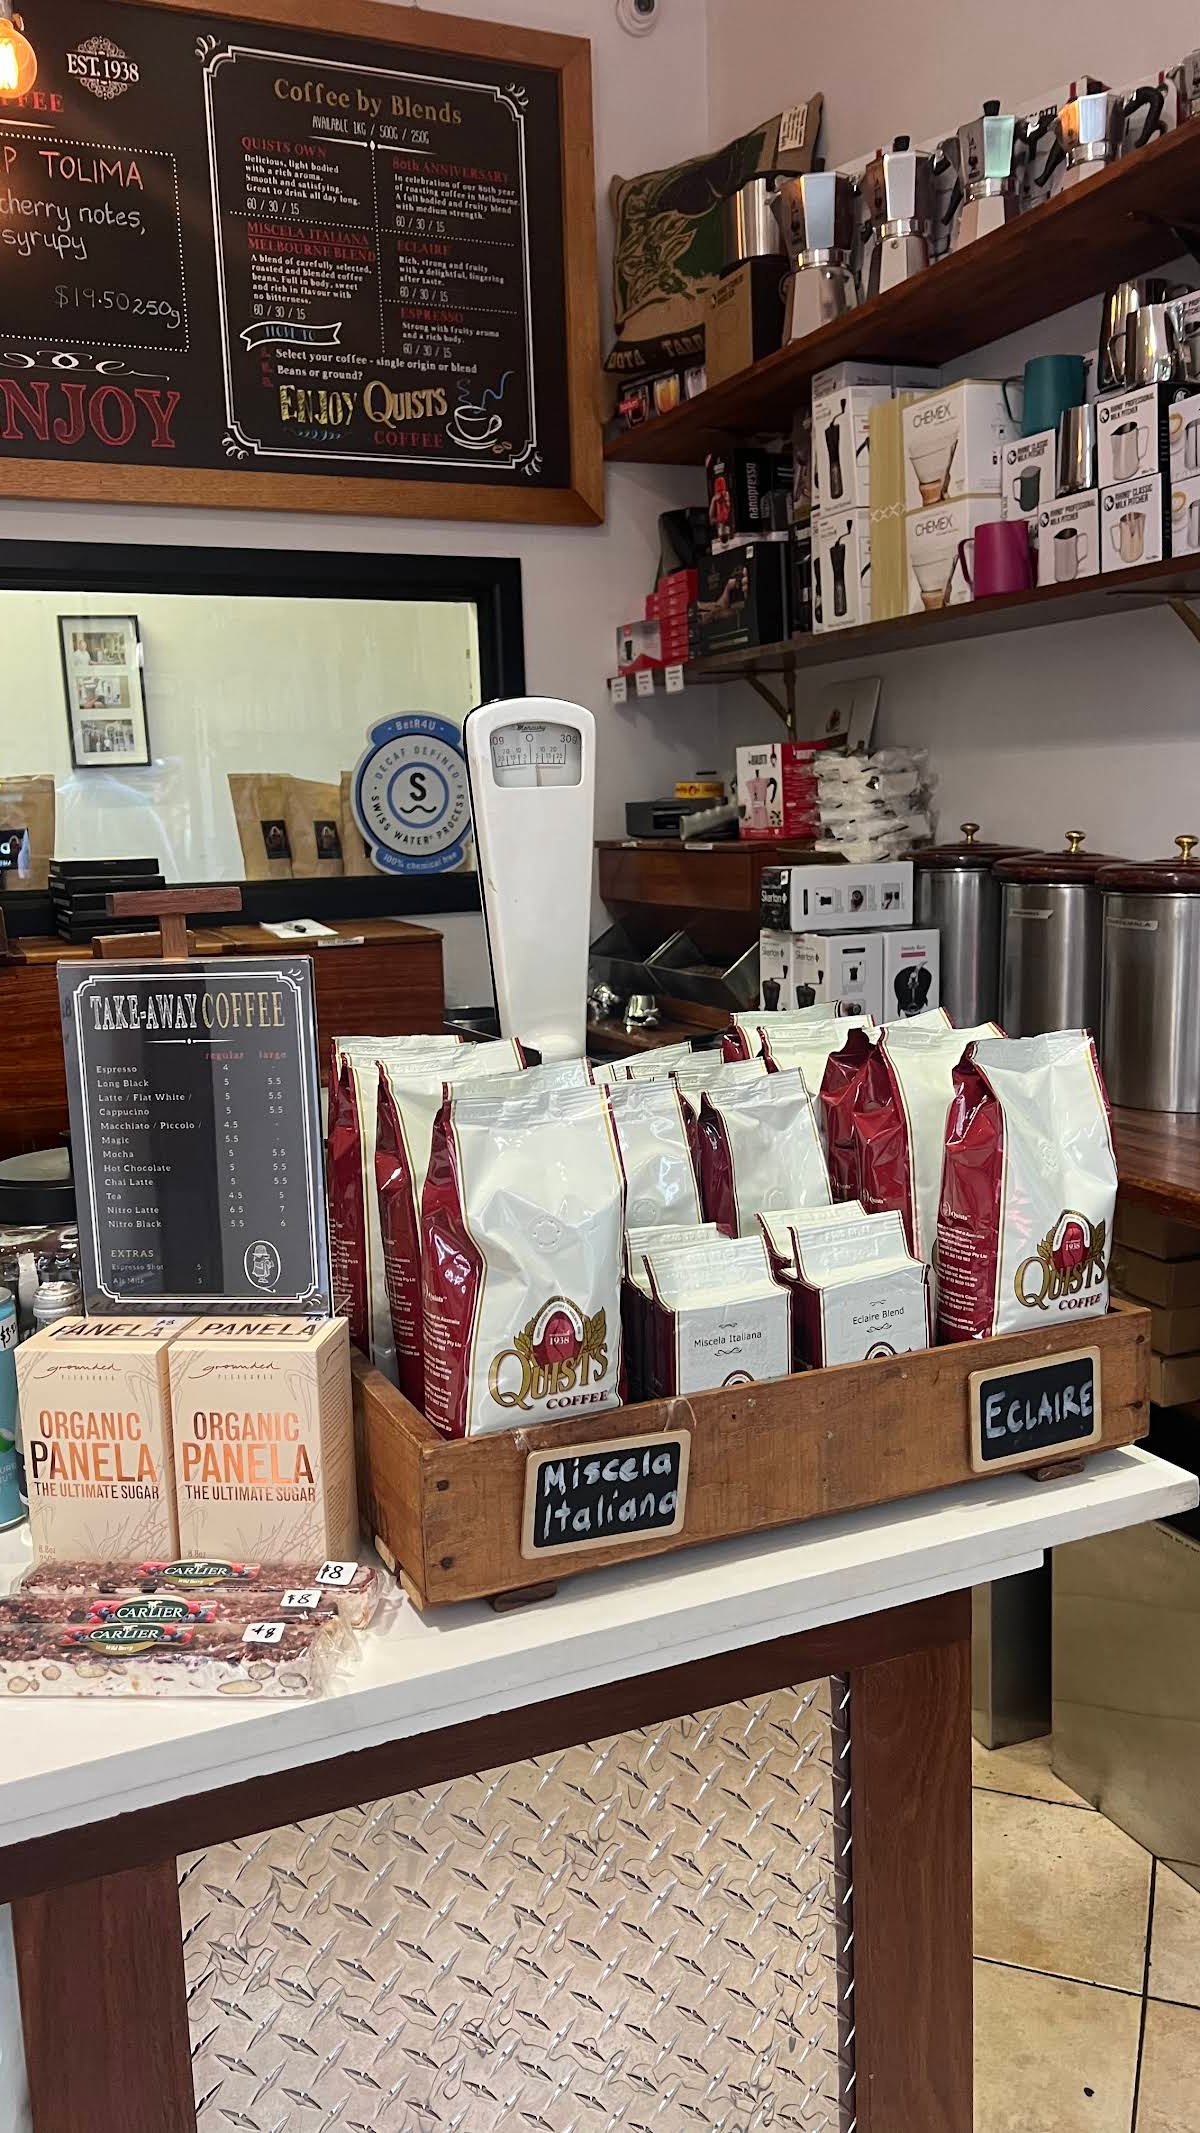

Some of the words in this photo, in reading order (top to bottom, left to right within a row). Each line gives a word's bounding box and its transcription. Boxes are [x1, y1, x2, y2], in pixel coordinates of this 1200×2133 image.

[274, 78, 350, 108] Coffee
[357, 89, 382, 117] by
[391, 95, 462, 124] Blends
[312, 115, 348, 133] AVAILABLE
[353, 121, 366, 136] 1KG
[411, 129, 429, 144] 250G
[242, 137, 290, 151] QUISTS
[295, 144, 327, 157] OWN
[38, 150, 144, 191] TOLIMA
[245, 165, 265, 174] with
[275, 168, 292, 177] rich
[294, 172, 324, 181] aroma.
[289, 159, 308, 171] light
[311, 163, 339, 174] bodied
[423, 162, 508, 182] ANNIVERSARY
[246, 174, 278, 185] Smooth
[280, 179, 296, 187] and
[246, 184, 270, 194] Great
[273, 187, 282, 195] to
[285, 188, 307, 199] drink
[310, 191, 321, 200] all
[323, 193, 337, 203] day
[340, 195, 360, 206] long.
[0, 188, 71, 232] cherry
[79, 202, 146, 235] notes,
[248, 222, 304, 238] MISCELA
[310, 229, 368, 245] ITALIANA
[1, 229, 88, 260] syrupy
[248, 238, 331, 257] MELBOURNE
[334, 247, 376, 261] BLEND
[260, 255, 282, 264] blend
[296, 260, 333, 270] carefully
[252, 265, 283, 274] roasted
[303, 268, 335, 279] blended
[338, 273, 363, 281] coffee
[271, 284, 287, 293] rich
[301, 287, 331, 297] flavour
[333, 291, 351, 299] with
[54, 285, 130, 311] $19.50
[132, 298, 181, 329] 250g
[276, 349, 306, 361] Select
[309, 353, 332, 366] your
[336, 355, 367, 364] coffee
[376, 358, 404, 369] single
[407, 360, 435, 372] origin
[451, 362, 477, 374] blend
[277, 365, 306, 376] Beans
[309, 369, 320, 377] or
[323, 369, 363, 381] ground?
[280, 384, 358, 426] ENJOY
[363, 380, 448, 429] QUISTS
[913, 403, 951, 428] CHEMEX
[374, 431, 443, 448] COFFEE
[746, 463, 759, 520] nanopresso
[915, 514, 953, 537] CHEMEX
[375, 748, 405, 780] DECAF
[414, 745, 460, 778] DEFINED
[409, 772, 427, 802] S
[371, 795, 391, 832] SWISS
[437, 793, 465, 840] PROCESS
[383, 854, 404, 868] 100%
[406, 859, 442, 871] chemical
[90, 993, 198, 1030] TAKE-AWAY
[202, 992, 286, 1029] COFFEE
[205, 1051, 245, 1062] regular
[259, 1050, 287, 1061] large
[96, 1066, 137, 1075] Espresso
[97, 1080, 120, 1088] Long
[123, 1079, 149, 1087] Black
[267, 1077, 282, 1086] 5.5
[99, 1094, 123, 1102] Latte
[268, 1091, 283, 1100] 5.5
[99, 1108, 150, 1117] Cappucino
[100, 1122, 150, 1130] Macchiato
[160, 1121, 195, 1130] Piccolo
[101, 1136, 130, 1145] Magic
[103, 1150, 134, 1158] Mocha
[123, 1164, 171, 1172] Chocolate
[104, 1178, 126, 1186] Chai
[129, 1178, 153, 1186] Latte
[106, 1192, 121, 1200] Tea
[107, 1206, 132, 1214] Nitro
[135, 1206, 159, 1214] Latte
[108, 1220, 133, 1228] Nitro
[136, 1220, 162, 1228] Black
[111, 1249, 154, 1258] EXTRAS
[1014, 1250, 1106, 1311] QUISTS
[852, 1312, 880, 1325] Eclaire
[882, 1306, 905, 1319] Blend
[48, 1323, 164, 1338] PANELA
[198, 1322, 318, 1337] PANELA
[549, 1336, 570, 1345] 1938
[694, 1337, 726, 1348] Miscela
[729, 1330, 762, 1345] Italiana
[33, 1363, 123, 1380] grounded
[188, 1361, 281, 1379] grounded
[488, 1342, 609, 1410] QUISTS
[546, 1390, 609, 1410] COFFEE
[985, 1379, 1093, 1439] ECLAIRE
[39, 1411, 142, 1441] ORGANIC
[194, 1411, 300, 1442] ORGANIC
[30, 1441, 158, 1483] PANELA
[182, 1442, 315, 1484] PANELA
[543, 1450, 672, 1497] Miscela
[34, 1482, 58, 1497] THE
[60, 1483, 120, 1499] ULTIMATE
[121, 1485, 160, 1501] SUGAR
[187, 1485, 210, 1500] THE
[212, 1485, 273, 1502] ULTIMATE
[276, 1487, 317, 1503] SUGAR
[543, 1490, 677, 1540] Italiana
[163, 1565, 229, 1577] CARLIER
[116, 1605, 183, 1620] CARLIER
[89, 1628, 160, 1641] CARLIER
